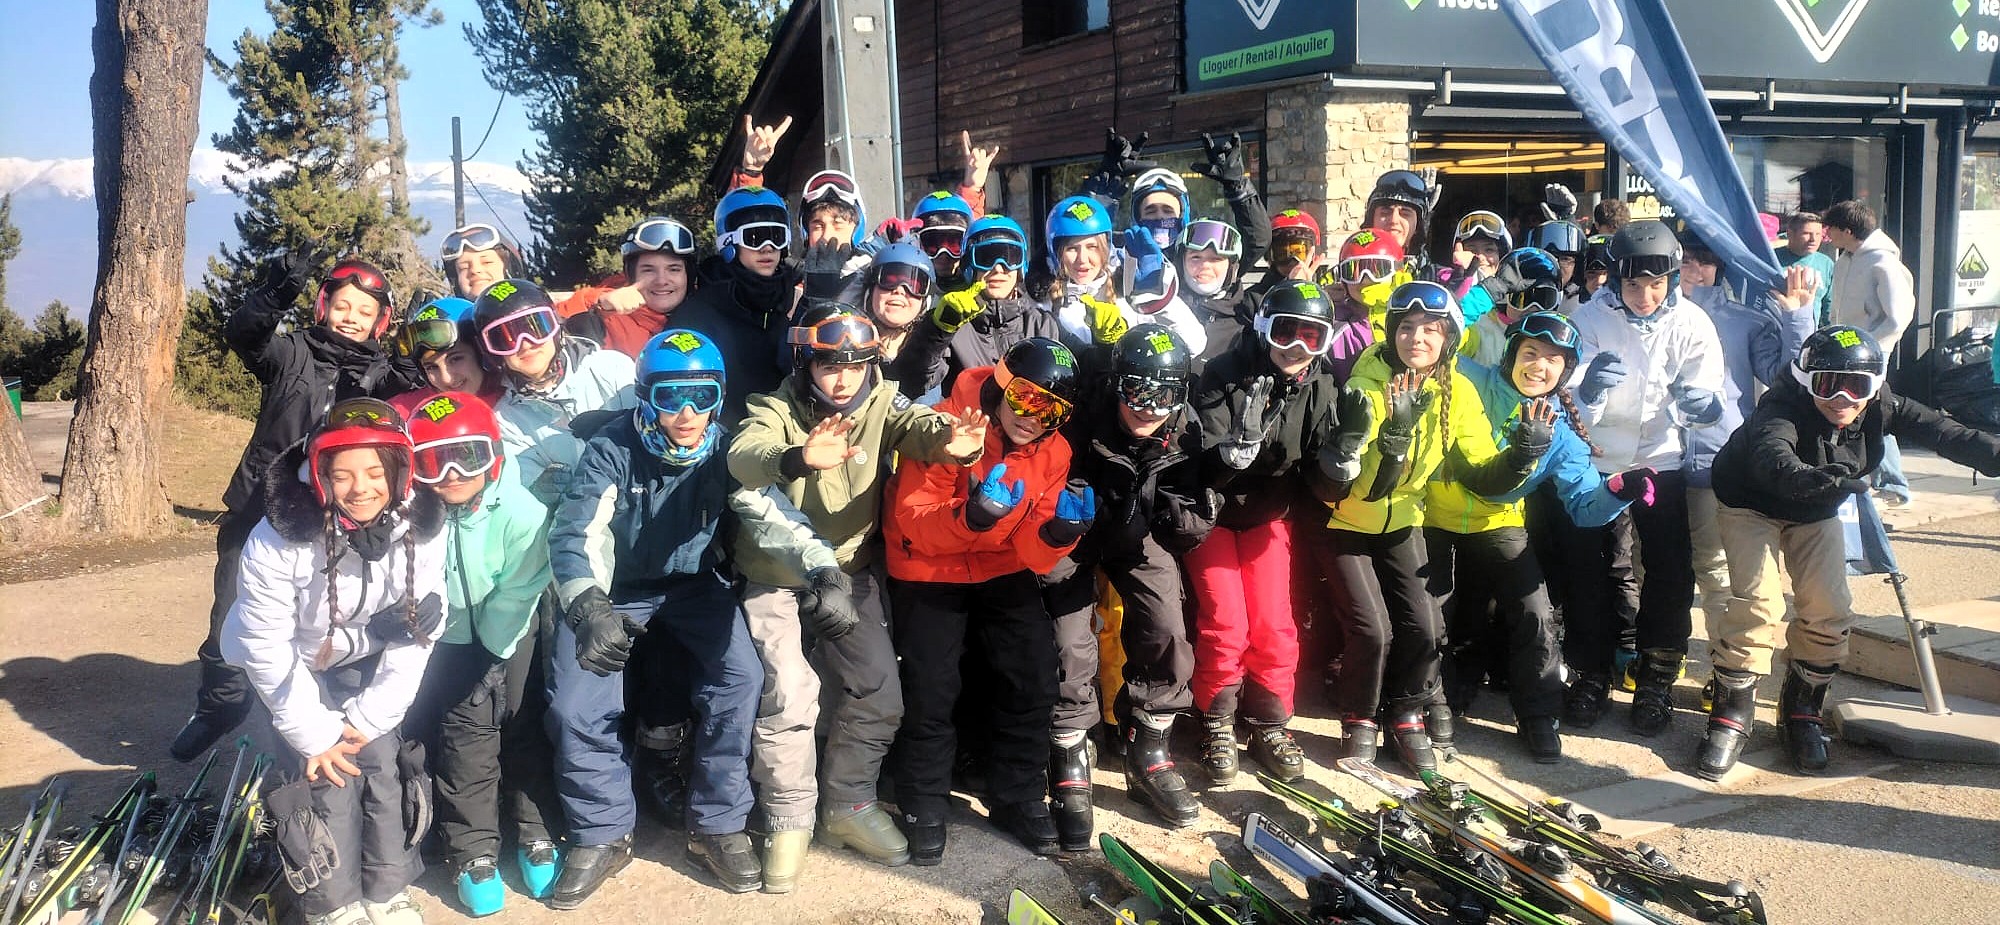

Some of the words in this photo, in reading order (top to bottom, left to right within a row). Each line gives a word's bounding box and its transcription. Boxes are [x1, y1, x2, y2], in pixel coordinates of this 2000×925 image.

[1978, 0, 2000, 21] Re
[1203, 56, 1238, 75] Lloguer
[1245, 46, 1277, 65] Rental
[1286, 37, 1328, 57] Alquiler
